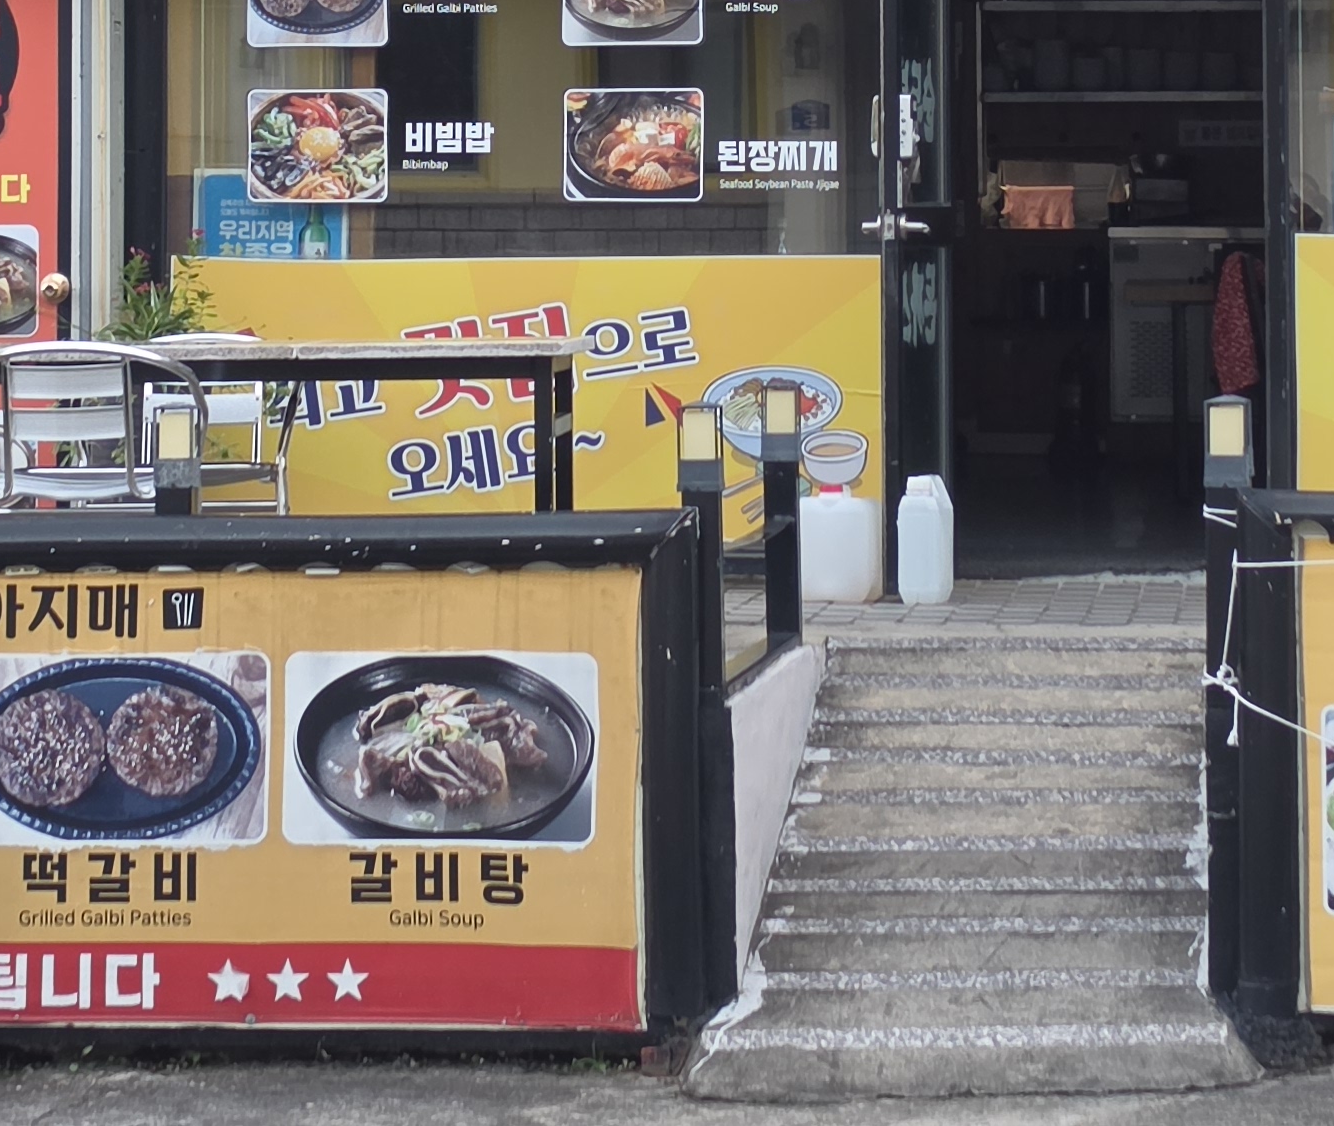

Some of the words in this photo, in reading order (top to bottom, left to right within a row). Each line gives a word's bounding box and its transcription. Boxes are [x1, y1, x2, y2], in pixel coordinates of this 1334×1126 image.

[402, 2, 435, 14] Grilled
[436, 2, 462, 14] Galbi
[463, 2, 498, 13] Patties
[725, 2, 751, 12] Galbi
[752, 2, 779, 14] Soup
[405, 121, 495, 154] 비빔밥
[402, 159, 449, 172] Bibimbap
[717, 140, 838, 172] 된장찌개
[718, 177, 754, 190] Seafood
[754, 177, 790, 191] Soybean
[791, 177, 815, 189] Paste
[219, 220, 294, 241] 우리지역
[22, 851, 198, 904] 떡갈비
[349, 851, 529, 905] 갈비탕
[18, 909, 75, 927] Grilled
[80, 909, 125, 927] Galbi
[130, 909, 192, 926] Patties
[389, 909, 433, 926] Galbi
[439, 909, 485, 931] Soup
